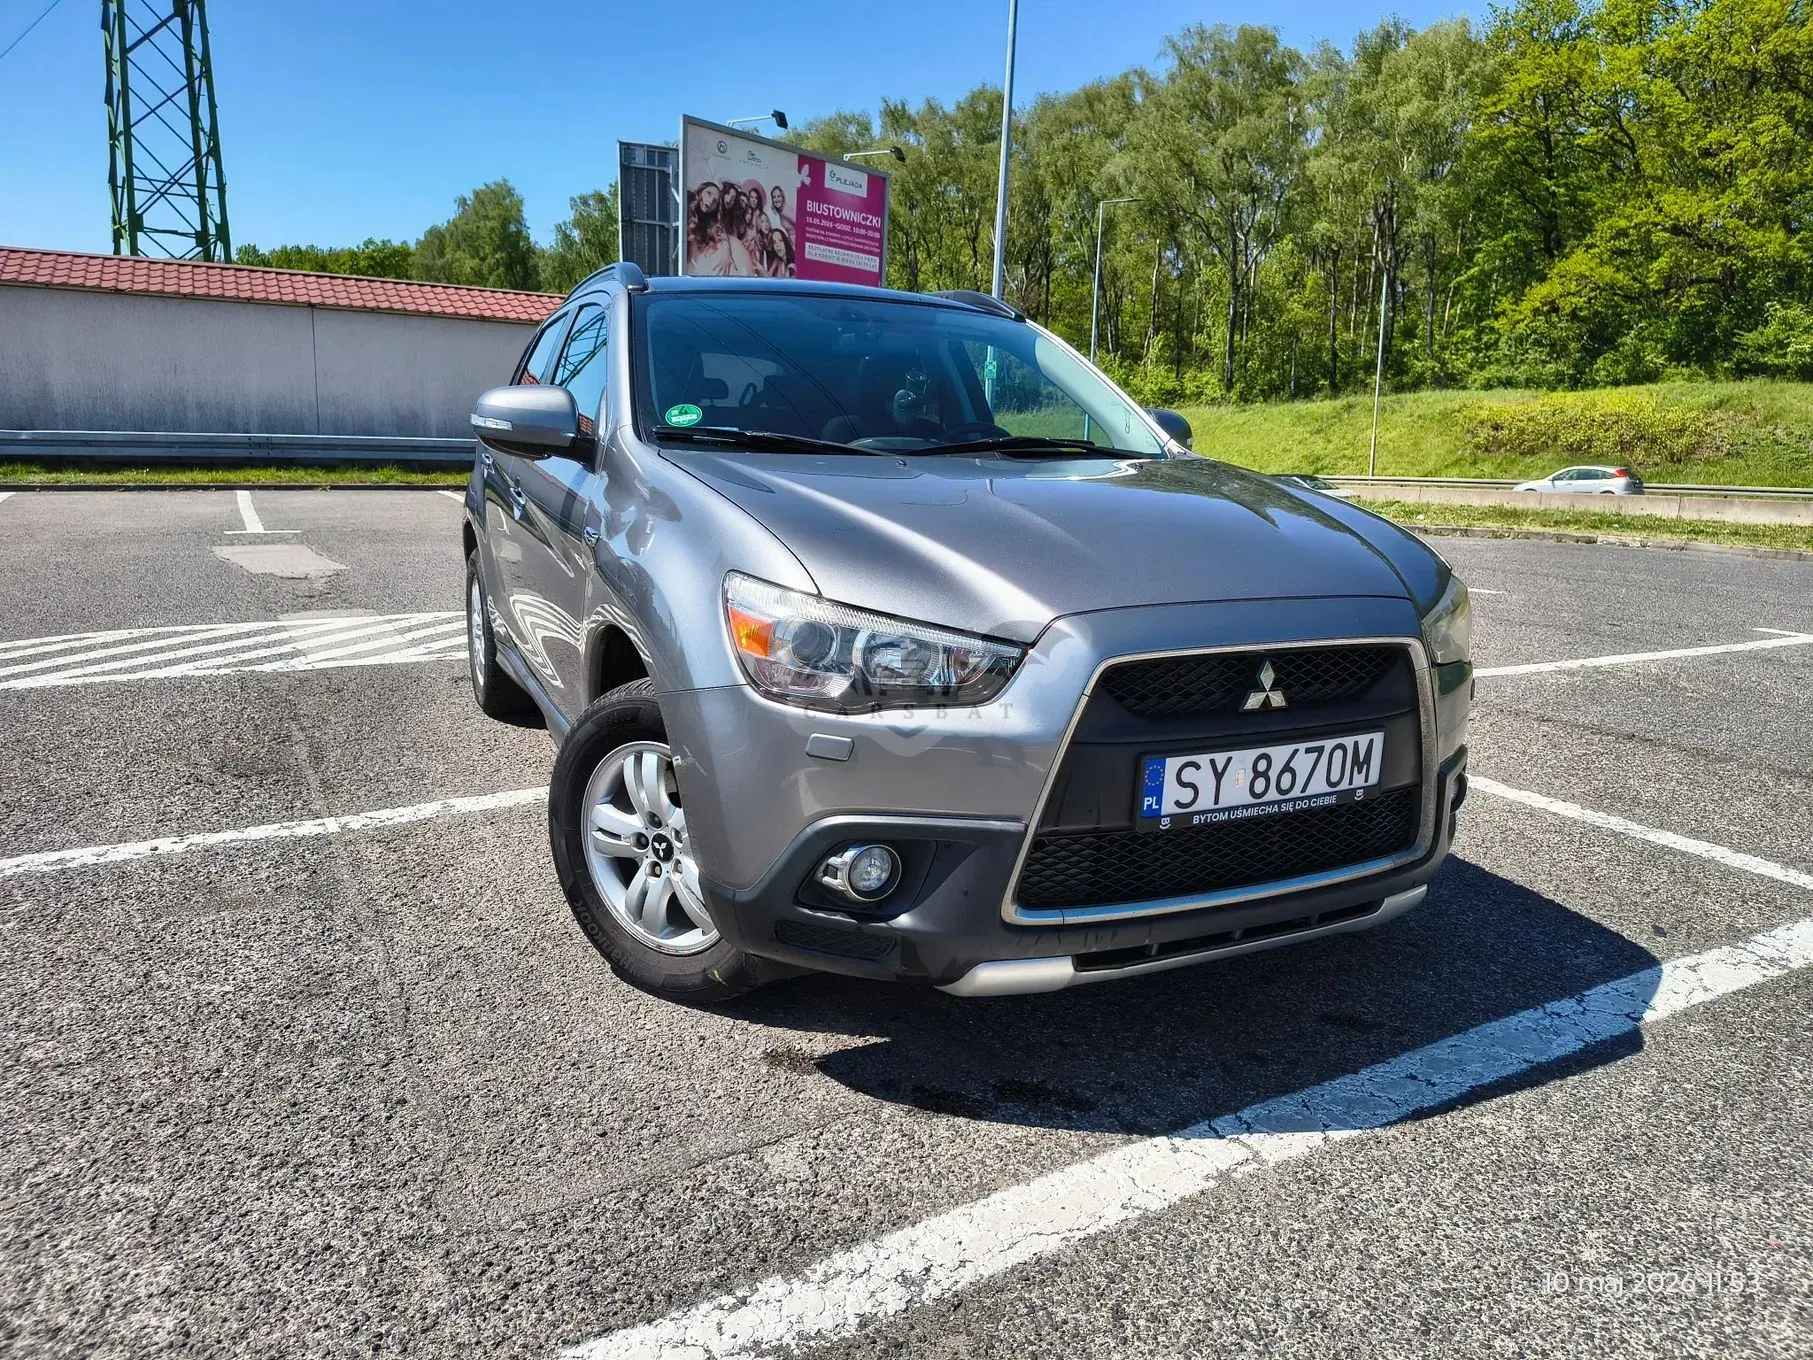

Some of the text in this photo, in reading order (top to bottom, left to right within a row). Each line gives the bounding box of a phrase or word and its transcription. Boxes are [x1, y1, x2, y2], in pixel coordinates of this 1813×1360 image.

[835, 177, 863, 189] PLEJADA
[806, 200, 881, 228] BIUSTOWNICZKI
[1173, 738, 1374, 810] SY 8670M
[1143, 796, 1159, 811] PL
[1192, 794, 1337, 825] BYTOM UŚMIECHA SIĘ DO CIEBIE
